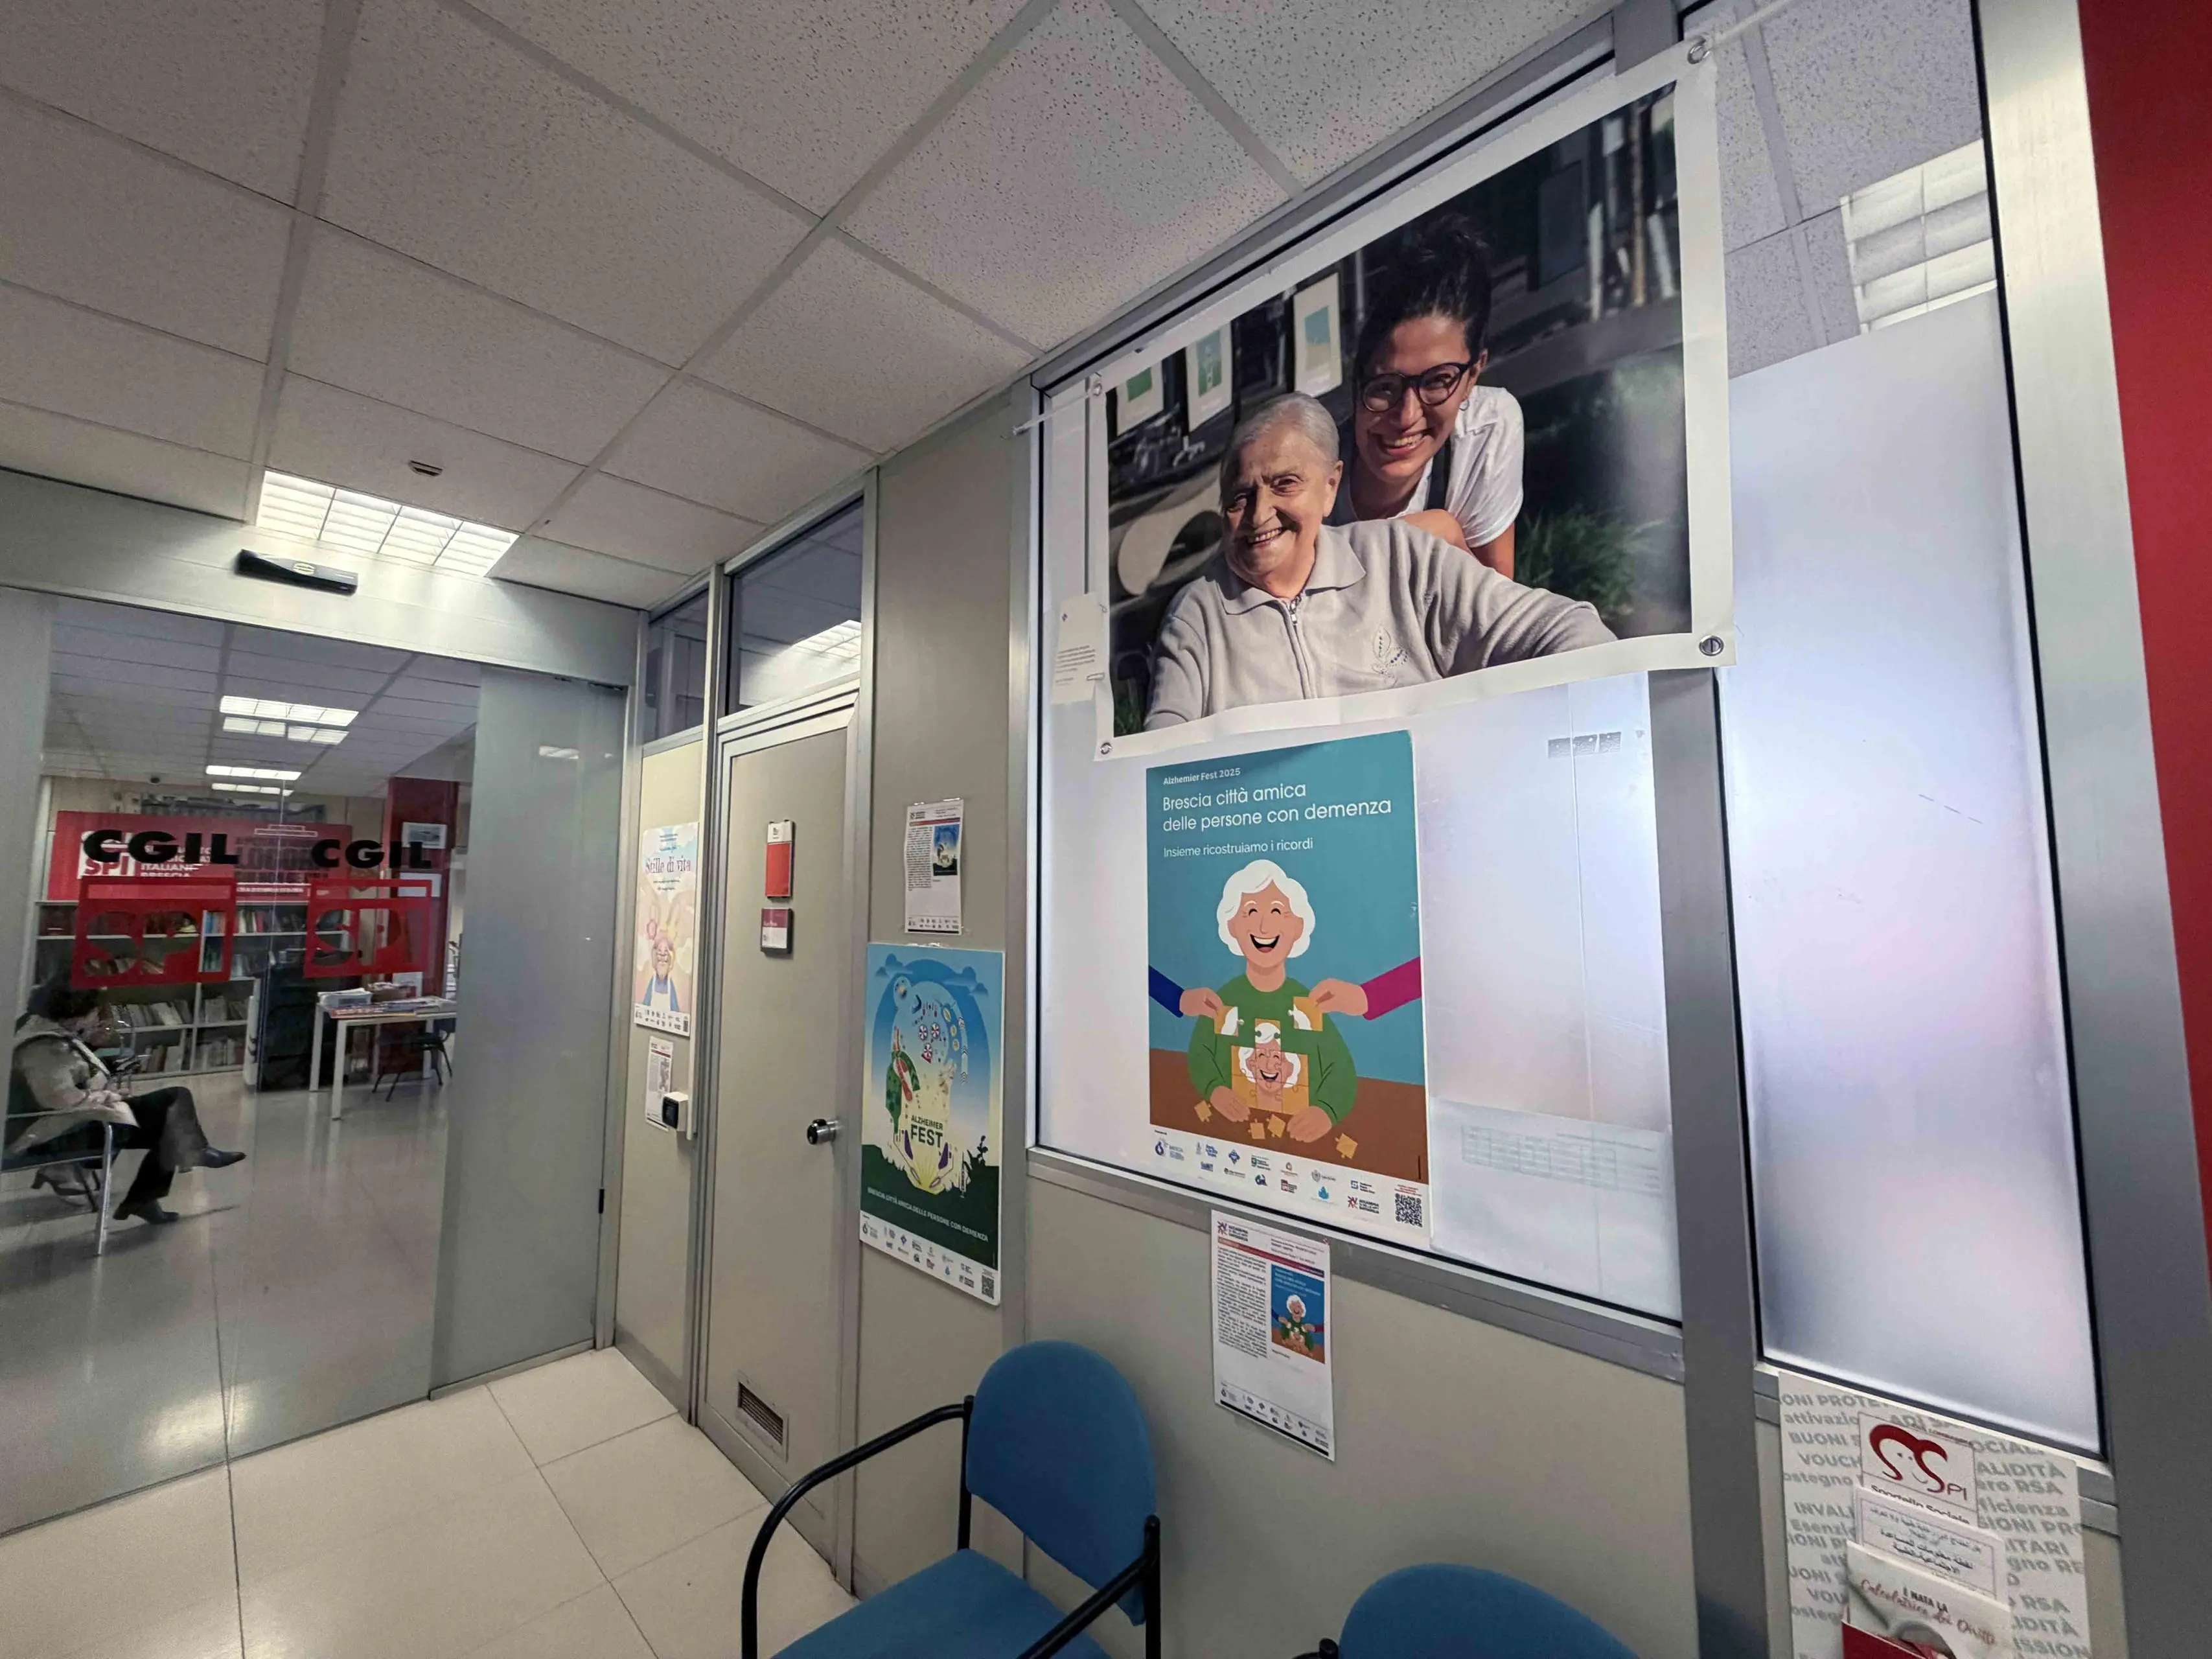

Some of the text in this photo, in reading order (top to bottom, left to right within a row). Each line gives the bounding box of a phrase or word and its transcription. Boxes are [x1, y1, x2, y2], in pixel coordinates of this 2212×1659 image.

[1201, 771, 1218, 781] Fest
[1219, 767, 1241, 778] 2025
[1162, 783, 1306, 811] Brescia città amica
[1163, 799, 1392, 832] delle persone con demenza
[84, 830, 239, 864] CGIL
[312, 839, 432, 869] CGIL
[1164, 837, 1313, 859] Insieme ricostruiamo i ricordi
[676, 855, 691, 872] vita
[911, 1114, 943, 1130] ALZHEIMER
[911, 1124, 943, 1148] FEST
[1817, 1395, 1889, 1408] PROTE
[2014, 1479, 2064, 1495] RSA
